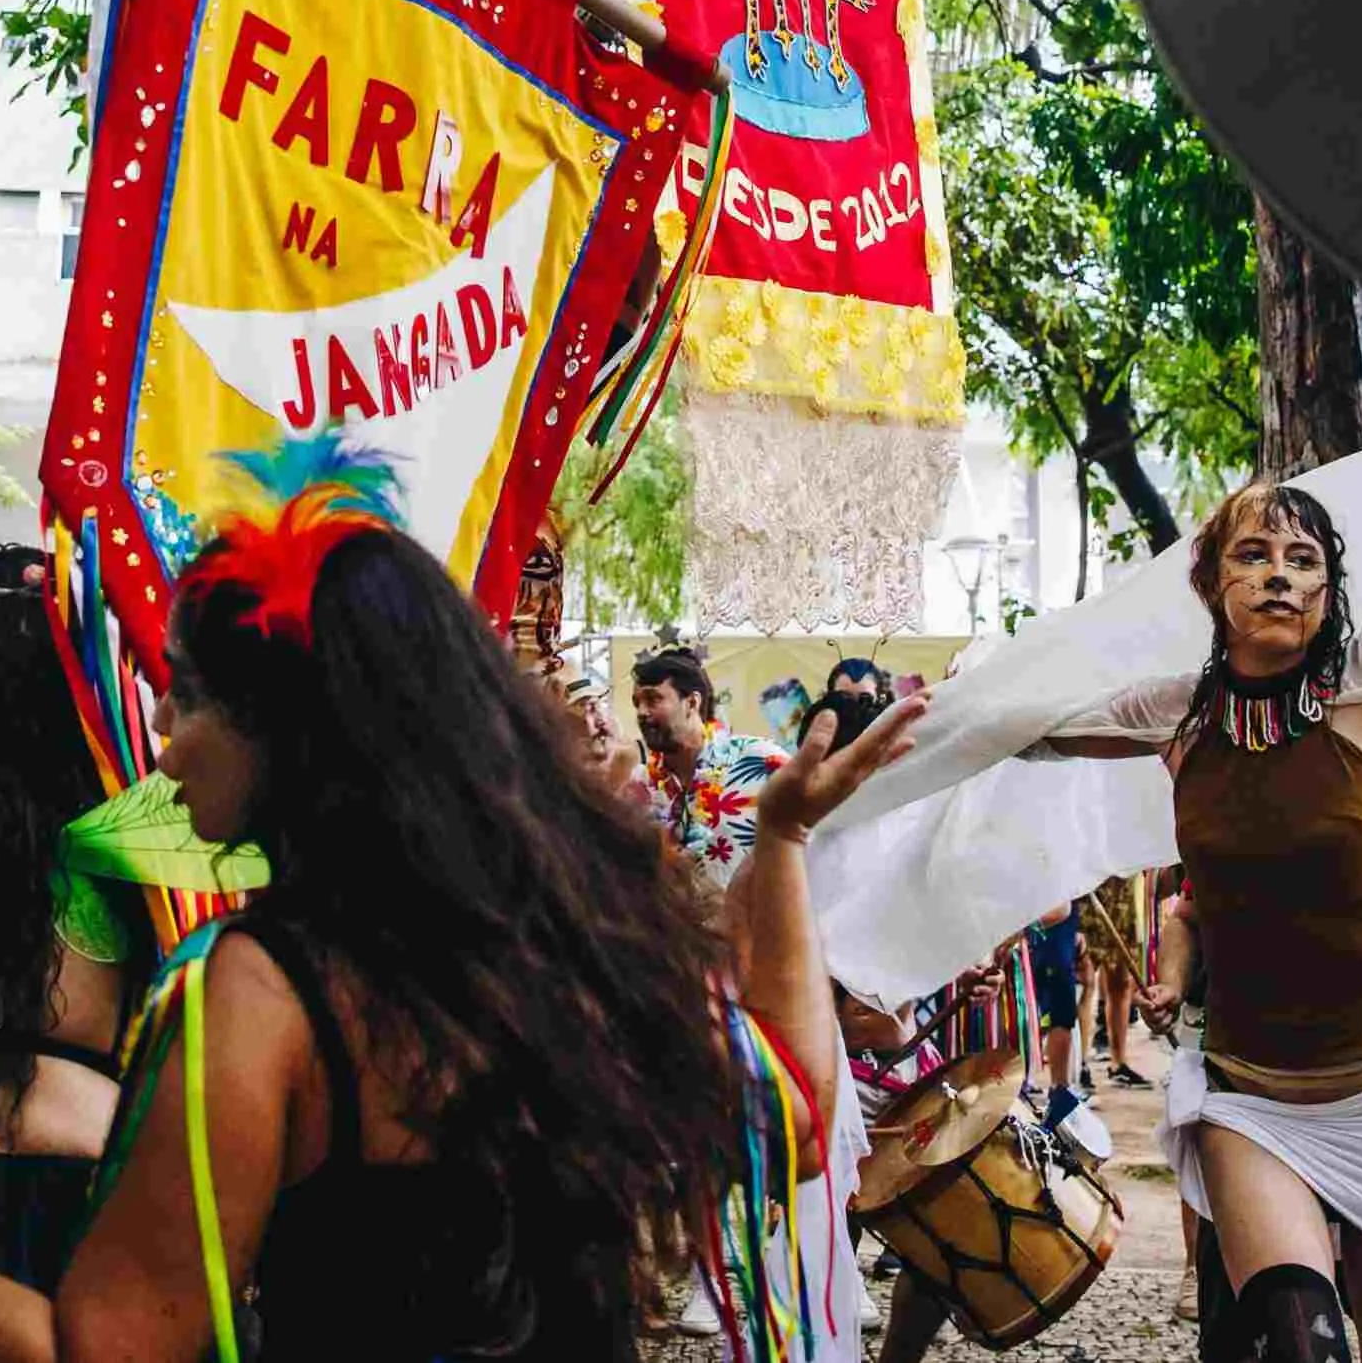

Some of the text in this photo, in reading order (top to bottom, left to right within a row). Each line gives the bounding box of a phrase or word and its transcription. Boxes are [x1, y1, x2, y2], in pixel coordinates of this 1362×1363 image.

[218, 10, 501, 259] FARRA
[681, 141, 922, 252] DESDE 2012
[282, 201, 338, 270] NA
[282, 265, 528, 429] JANGADA
